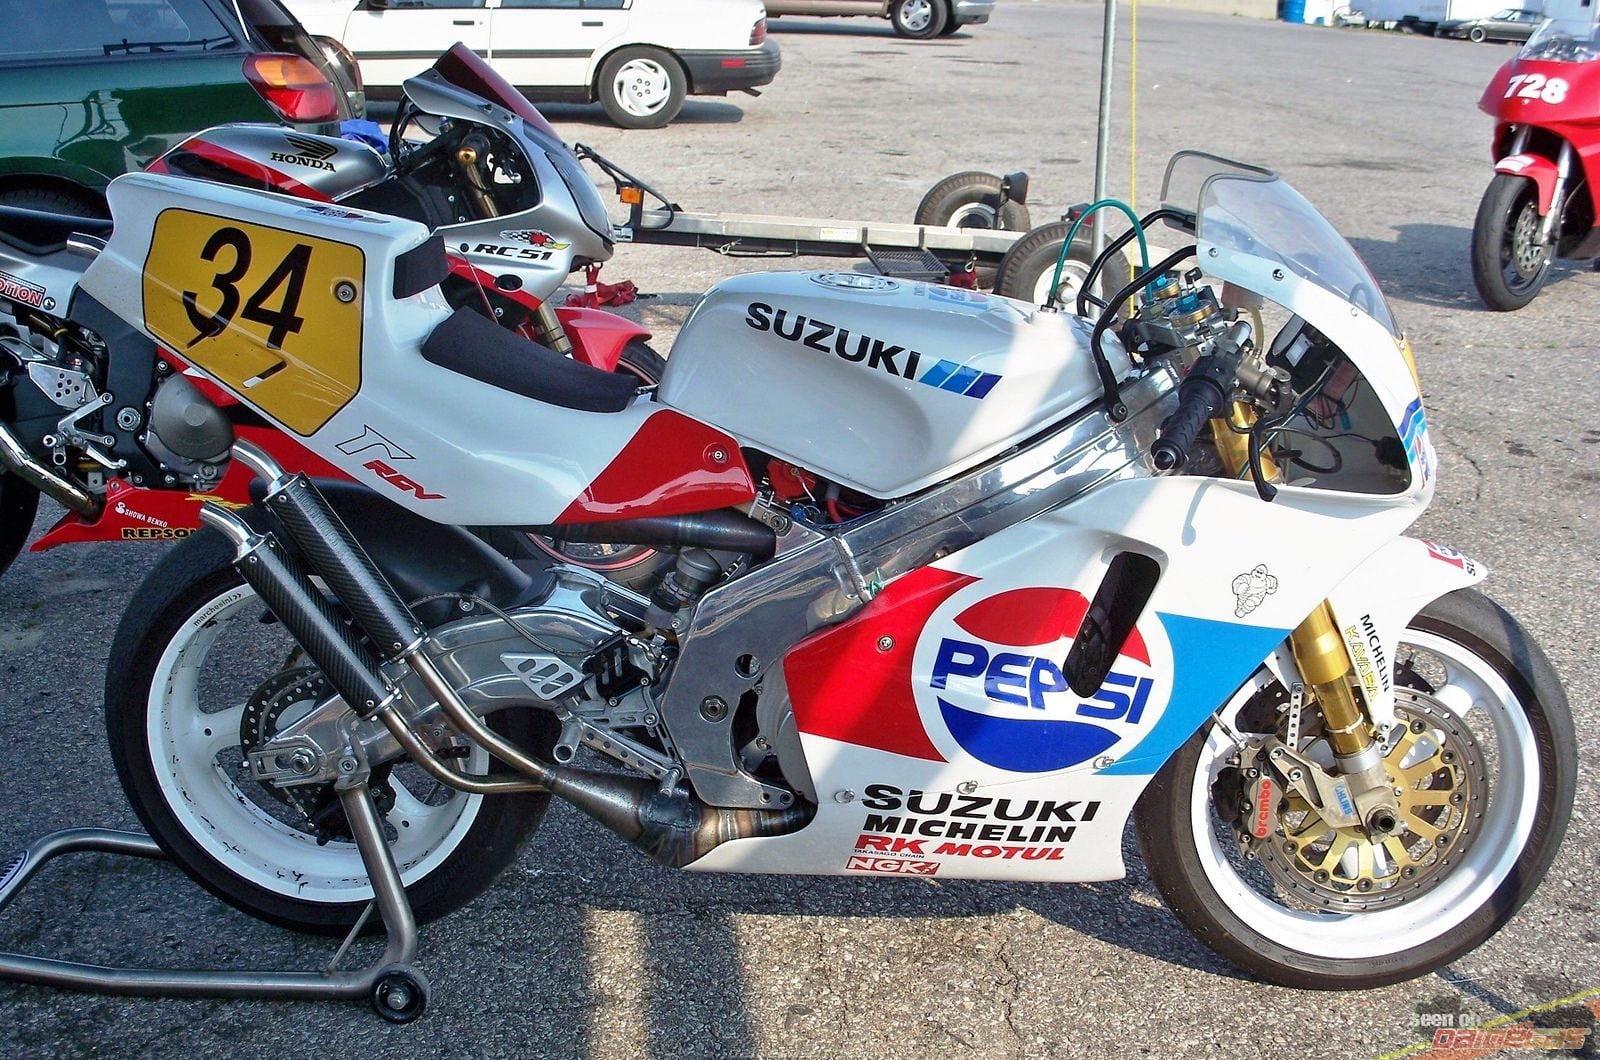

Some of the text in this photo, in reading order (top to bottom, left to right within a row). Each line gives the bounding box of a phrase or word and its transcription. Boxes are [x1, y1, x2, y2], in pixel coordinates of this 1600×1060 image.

[1503, 73, 1569, 104] 728
[270, 152, 336, 172] HONDA
[182, 227, 313, 350] 34
[745, 302, 921, 381] SUZUKI
[362, 460, 447, 499] RGV
[124, 508, 168, 528] SHOWA BENKO
[1360, 613, 1390, 693] MICHELIN
[930, 637, 1155, 725] PEPSI
[861, 784, 1102, 822] SUZUKI
[1254, 779, 1272, 838] brembo
[862, 814, 1077, 843] MICHELIN
[854, 834, 1065, 861] RK MOTUL
[854, 848, 897, 857] TAKASAGO
[847, 857, 923, 874] NGK
